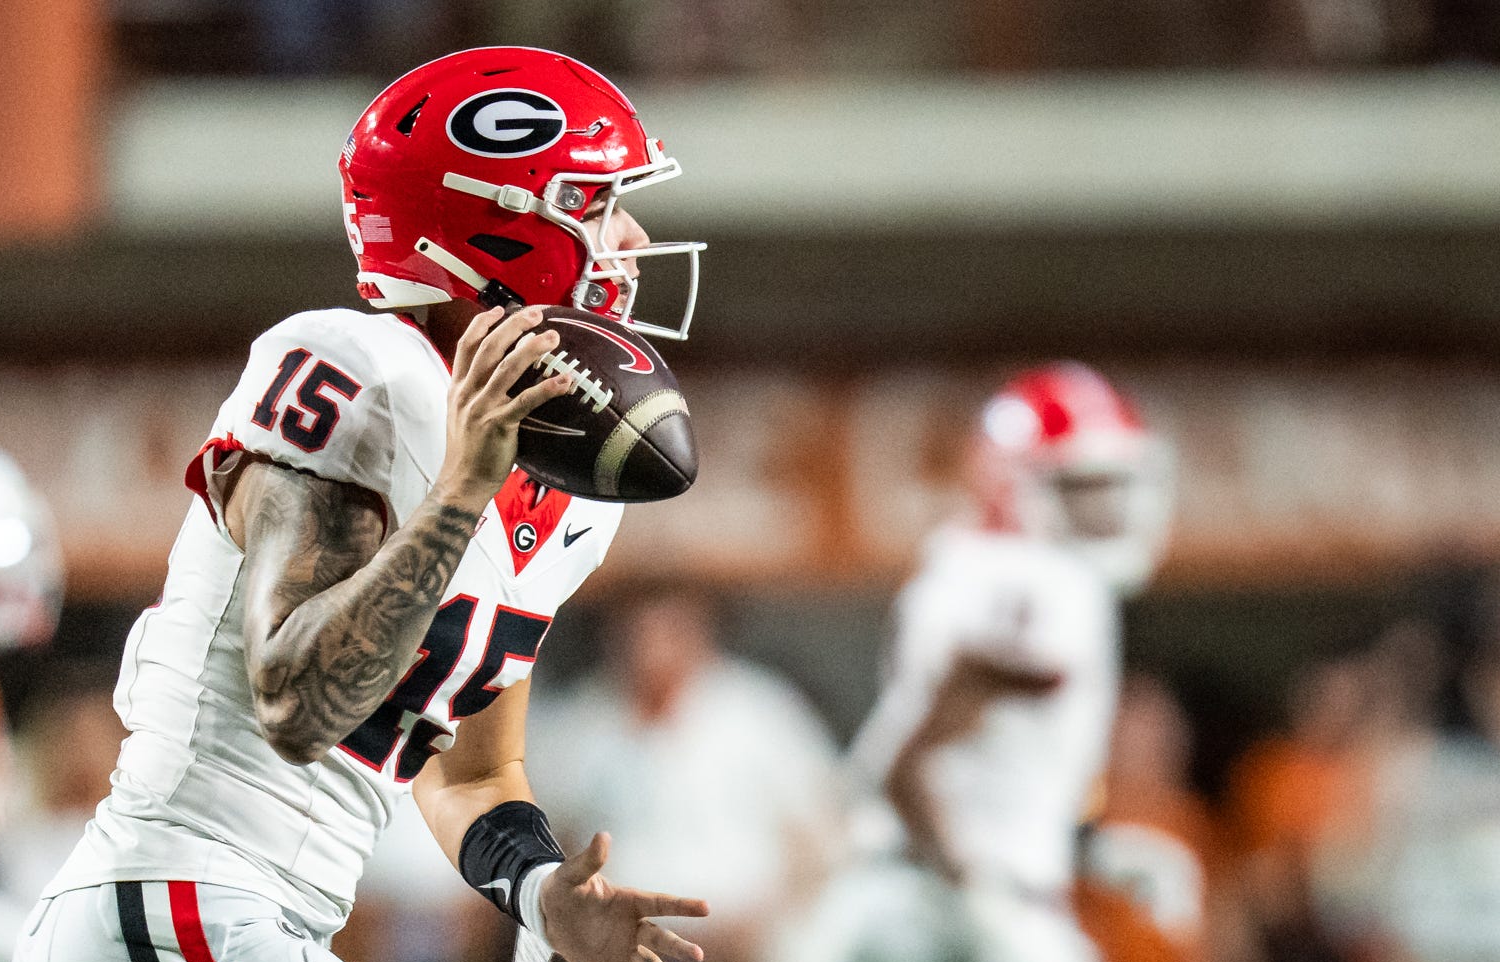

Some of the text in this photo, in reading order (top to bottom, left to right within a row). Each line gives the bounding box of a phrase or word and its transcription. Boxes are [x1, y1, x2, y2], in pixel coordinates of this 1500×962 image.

[451, 93, 563, 153] G
[252, 348, 360, 453] 15
[514, 524, 536, 552] G
[337, 593, 553, 783] 15
